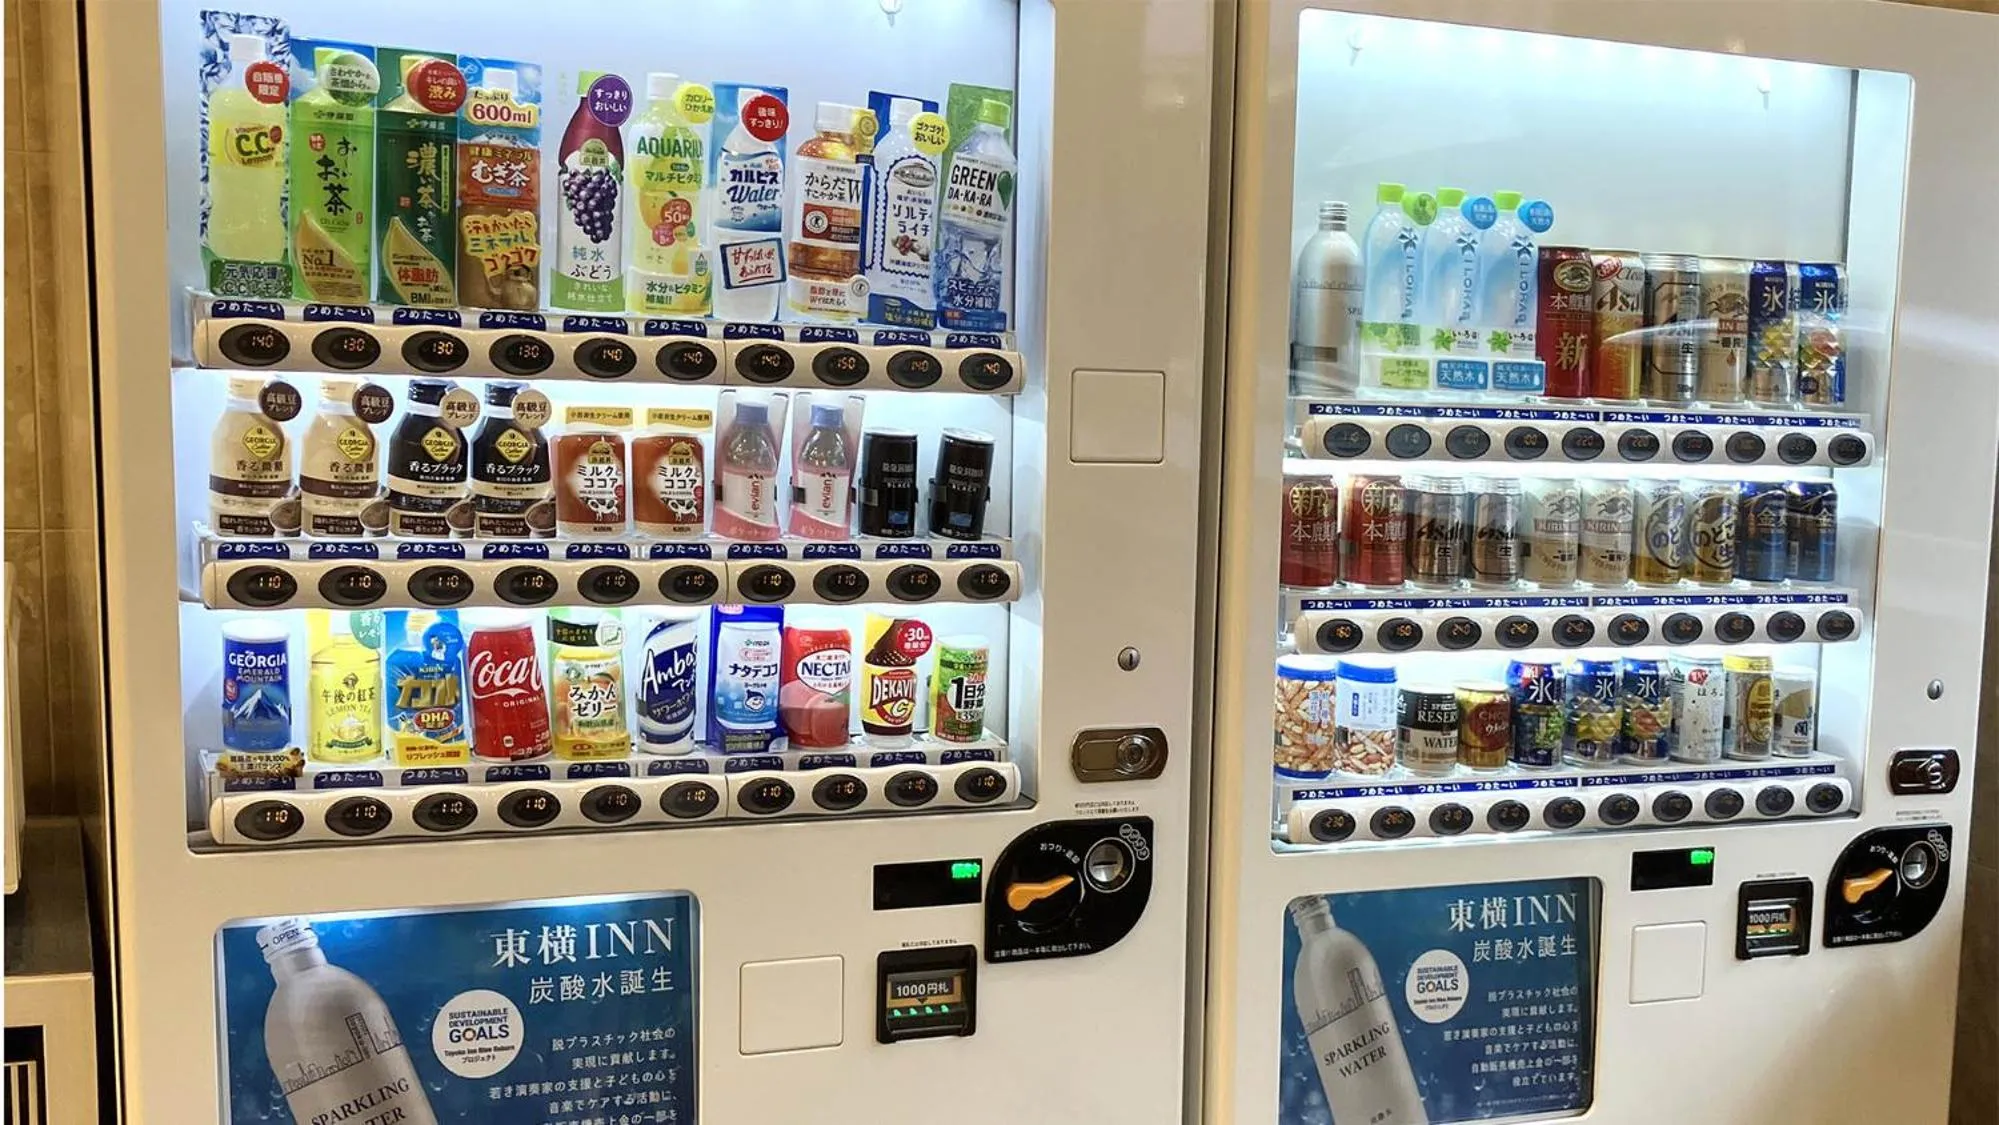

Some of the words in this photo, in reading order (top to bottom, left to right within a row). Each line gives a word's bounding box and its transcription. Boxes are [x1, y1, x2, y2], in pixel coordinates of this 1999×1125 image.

[428, 85, 457, 99] 渋み
[594, 88, 628, 101] すっきり
[685, 93, 713, 102] カロリー
[472, 103, 533, 124] 600ml
[594, 102, 628, 113] おいしい
[914, 132, 945, 146] おいしい
[470, 159, 530, 187] むぎ茶
[728, 168, 780, 185] カルピス
[951, 164, 998, 192] GREEN
[805, 171, 845, 191] からだ
[726, 184, 780, 203] Water
[571, 245, 606, 262] 純水
[570, 263, 613, 281] ぶどう
[1761, 285, 1785, 313] 氷
[1813, 289, 1836, 316] 氷
[252, 334, 274, 348] 140
[433, 340, 454, 355] 130
[1681, 341, 1694, 355] 生
[519, 344, 540, 358] 130
[1554, 331, 1589, 372] 新
[761, 354, 780, 367] 140
[1439, 369, 1476, 383] 天然水
[1494, 370, 1531, 384] 天然水
[446, 401, 478, 412] 高級豆
[515, 402, 548, 413] 高級豆
[448, 411, 475, 420] ブレンド
[518, 411, 547, 420] ブレンド
[408, 459, 464, 474] 香るブラック
[485, 462, 541, 475] 香るブラック
[583, 477, 619, 489] ココア
[664, 478, 698, 490] ココア
[750, 476, 761, 511] evian
[822, 477, 833, 509] evian
[1816, 507, 1834, 528] 金
[1586, 520, 1620, 534] KIRIN
[1499, 545, 1513, 557] 生
[258, 575, 281, 588] 110
[437, 575, 459, 588] 110
[523, 575, 544, 588] 110
[762, 574, 782, 586] 110
[228, 650, 288, 668] GEORGIA
[235, 674, 283, 684] MOUNTAIN
[237, 667, 280, 676] EMERALD
[569, 683, 617, 702] みかん
[1528, 677, 1553, 704] 氷
[1594, 678, 1615, 700] 氷
[1636, 676, 1656, 698] 氷
[420, 711, 450, 723] DHA
[572, 701, 617, 718] ゼリー
[686, 789, 706, 801] 110
[762, 785, 782, 798] 110
[441, 800, 463, 814] 110
[526, 796, 547, 810] 110
[266, 809, 288, 824] 110
[1446, 892, 1578, 933] 東横INN
[489, 917, 677, 969] 東横INN
[1471, 933, 1579, 963] 炭酸水誕生
[528, 965, 675, 1005] 炭酸水誕生
[896, 982, 949, 998] 1000円札
[1416, 979, 1460, 994] GOALS
[1487, 985, 1578, 1003] 脱プラスチック社会の
[448, 1007, 509, 1021] SUSTAINABLE
[448, 1016, 509, 1029] DEVELOPMENT
[449, 1024, 511, 1044] GOALS
[551, 1026, 676, 1052] 脱プラスチック社会の
[1323, 1020, 1391, 1067] SPARKLING
[571, 1048, 677, 1070] 実現に貢献します。
[1338, 1044, 1388, 1079] WATER
[487, 1067, 678, 1101] 若き演奏家の支援と子どもの心を
[311, 1077, 410, 1125] SPARKLING
[549, 1090, 678, 1115] 音楽でケアする活動に、
